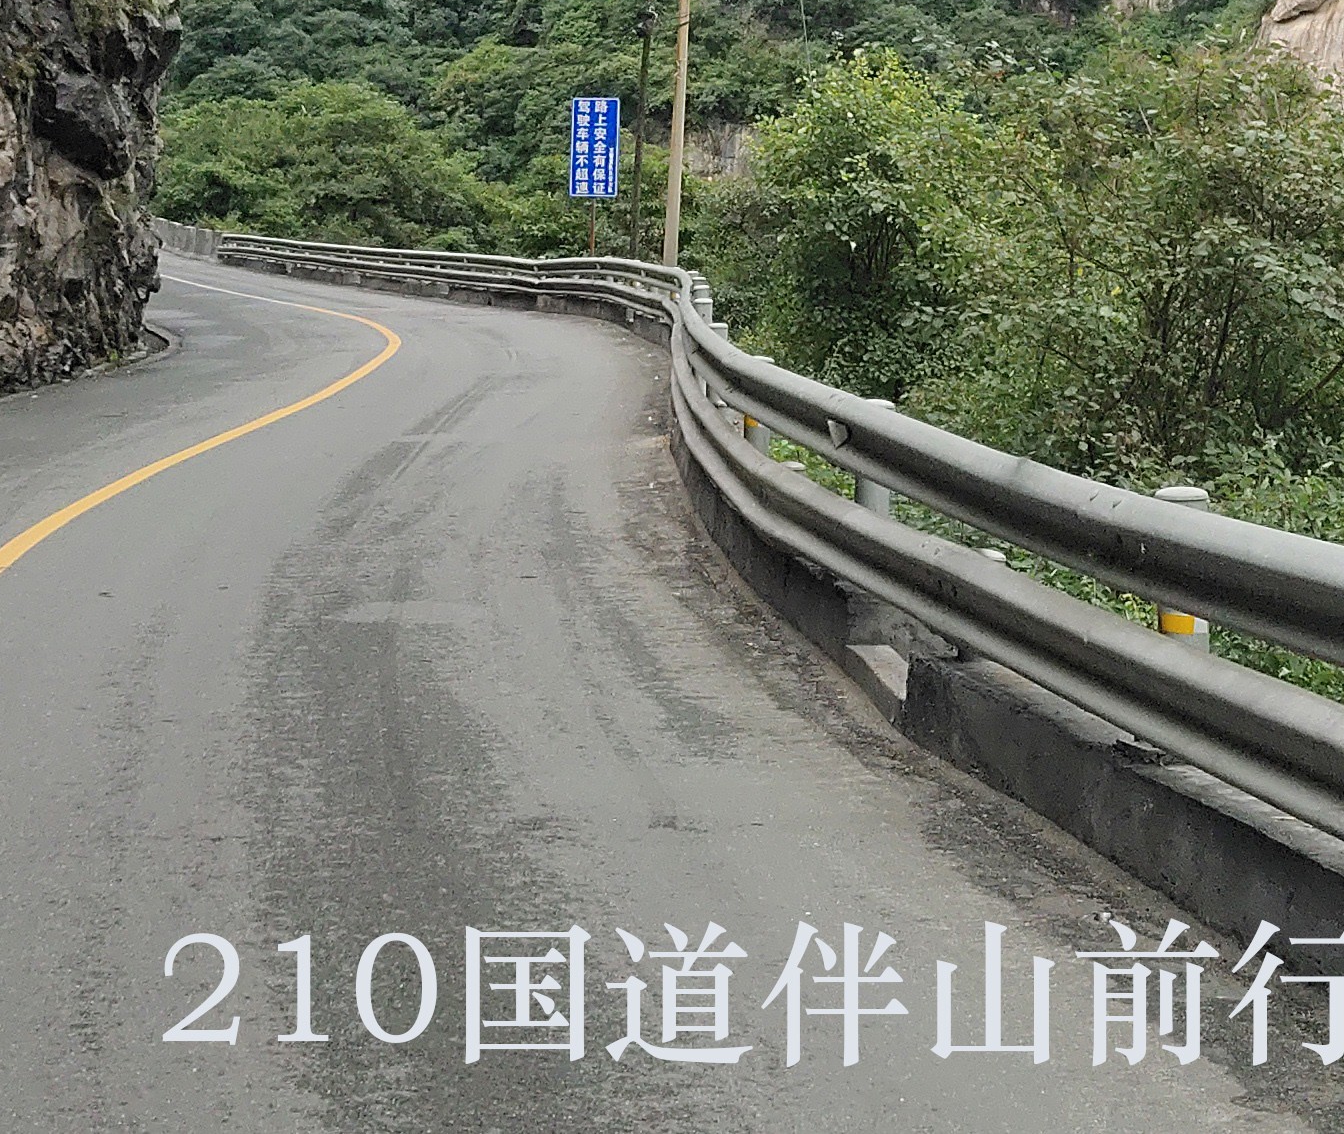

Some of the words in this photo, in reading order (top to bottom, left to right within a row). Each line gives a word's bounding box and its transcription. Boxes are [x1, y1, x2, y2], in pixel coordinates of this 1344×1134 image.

[575, 100, 590, 194] 驾驶车辆不超速
[593, 100, 608, 194] 路上安全有保证
